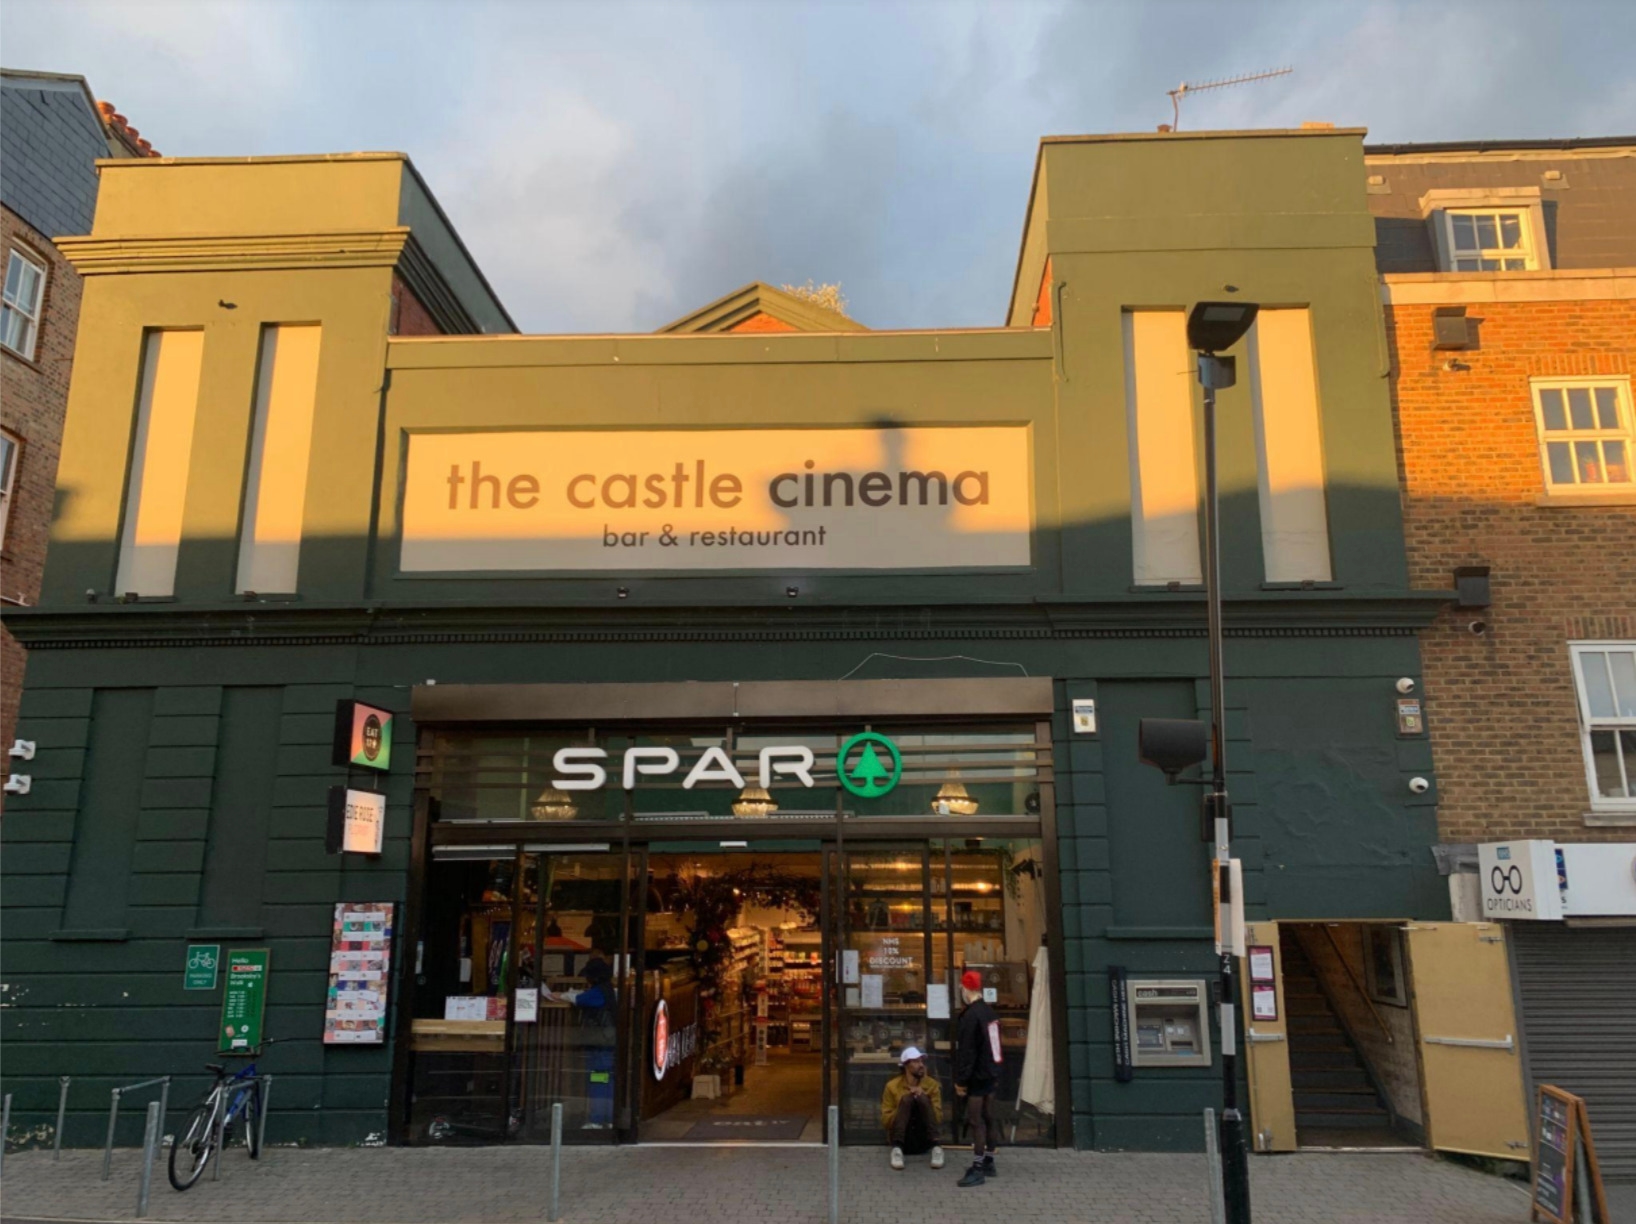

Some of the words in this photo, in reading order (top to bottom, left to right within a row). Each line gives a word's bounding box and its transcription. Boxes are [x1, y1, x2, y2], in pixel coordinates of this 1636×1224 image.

[447, 461, 540, 509] the
[567, 460, 743, 509] castle
[769, 459, 989, 508] cinema
[603, 524, 649, 548] bar
[658, 524, 679, 547] &
[690, 525, 827, 547] restaurant
[366, 727, 379, 738] EAT
[552, 746, 814, 790] SPAR
[1487, 897, 1532, 912] OPTICIANS
[869, 956, 913, 965] DISCOUNT
[1222, 964, 1232, 974] 4
[1137, 989, 1158, 998] cash
